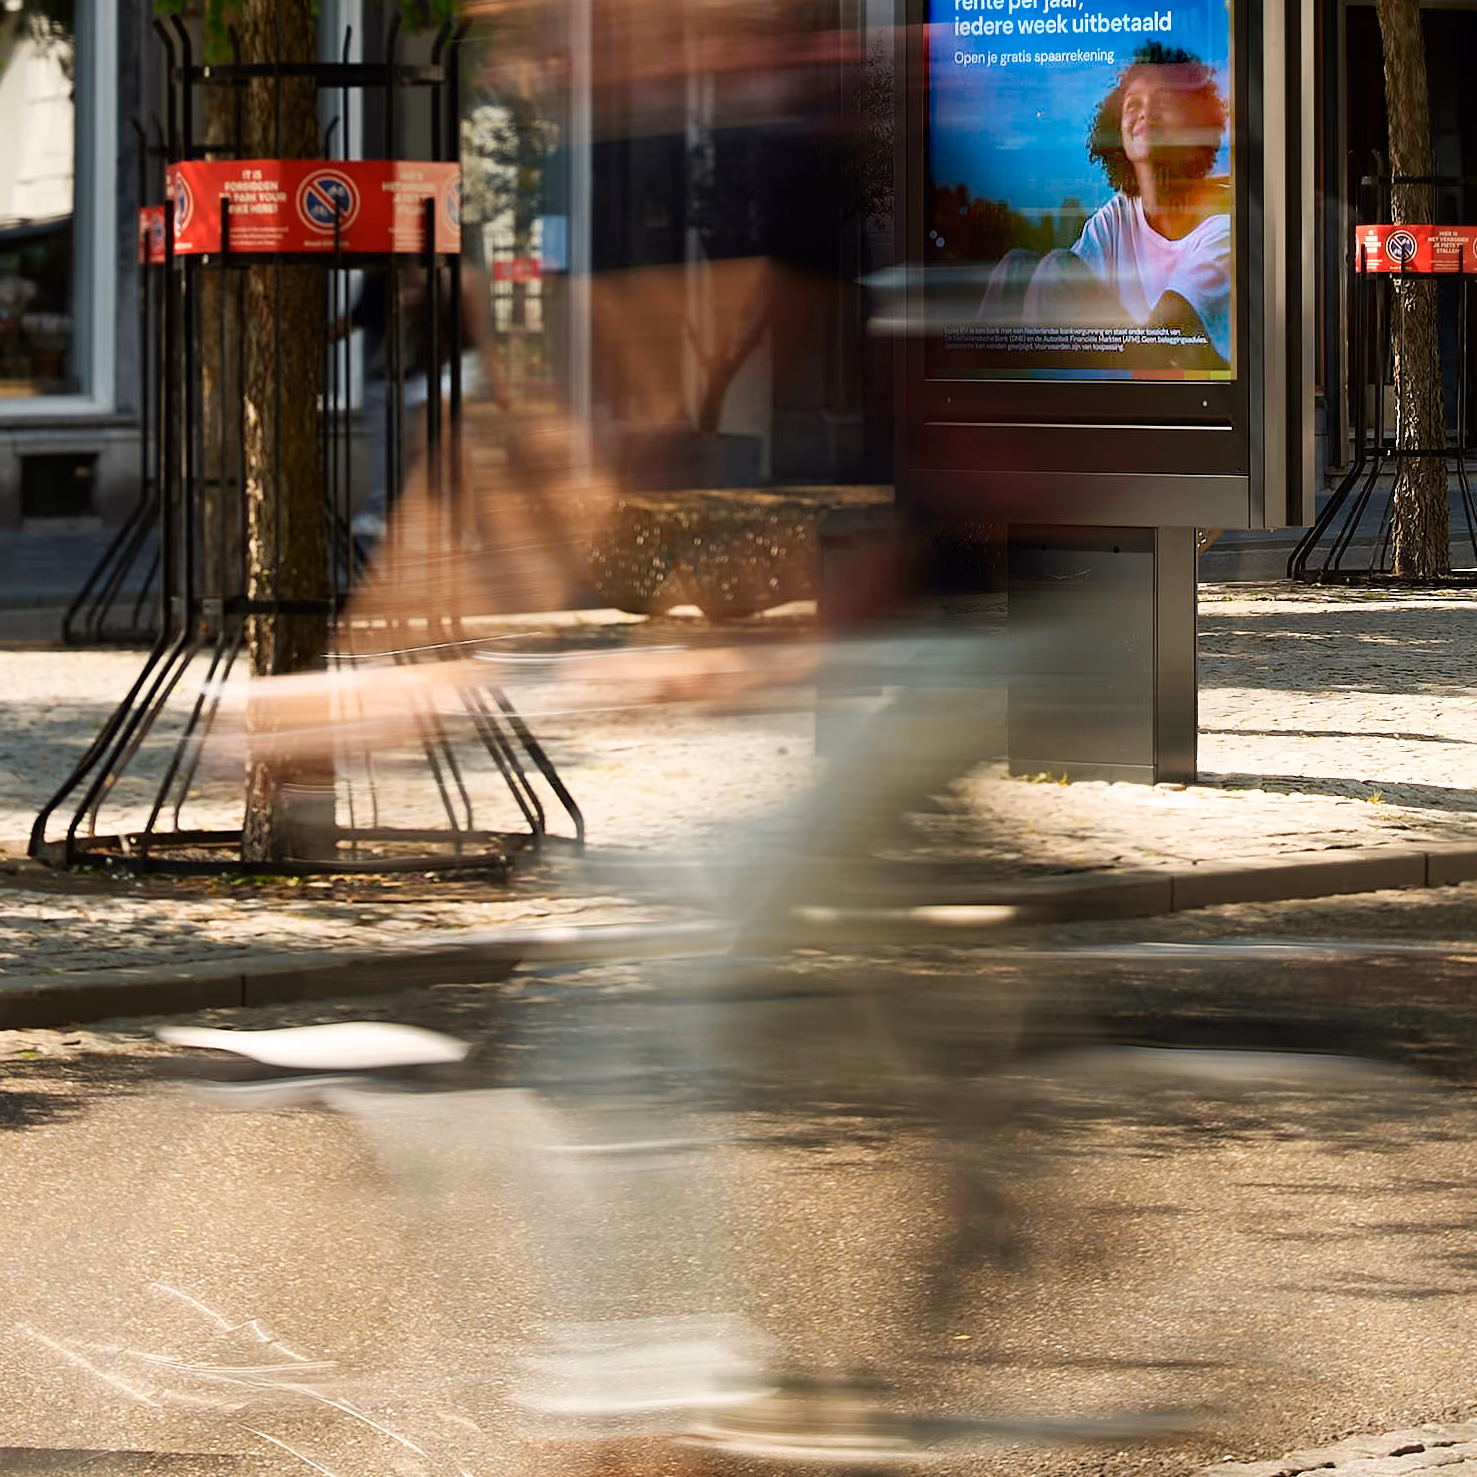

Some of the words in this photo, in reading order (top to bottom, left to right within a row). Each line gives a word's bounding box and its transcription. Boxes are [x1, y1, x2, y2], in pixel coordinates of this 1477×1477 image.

[954, 15, 1014, 37] iedere
[1017, 13, 1069, 35] week
[1072, 10, 1172, 33] uitbetaald
[954, 50, 986, 66] Open
[987, 50, 998, 66] je
[999, 49, 1032, 67] gratis
[1033, 47, 1115, 66] spaarrekening
